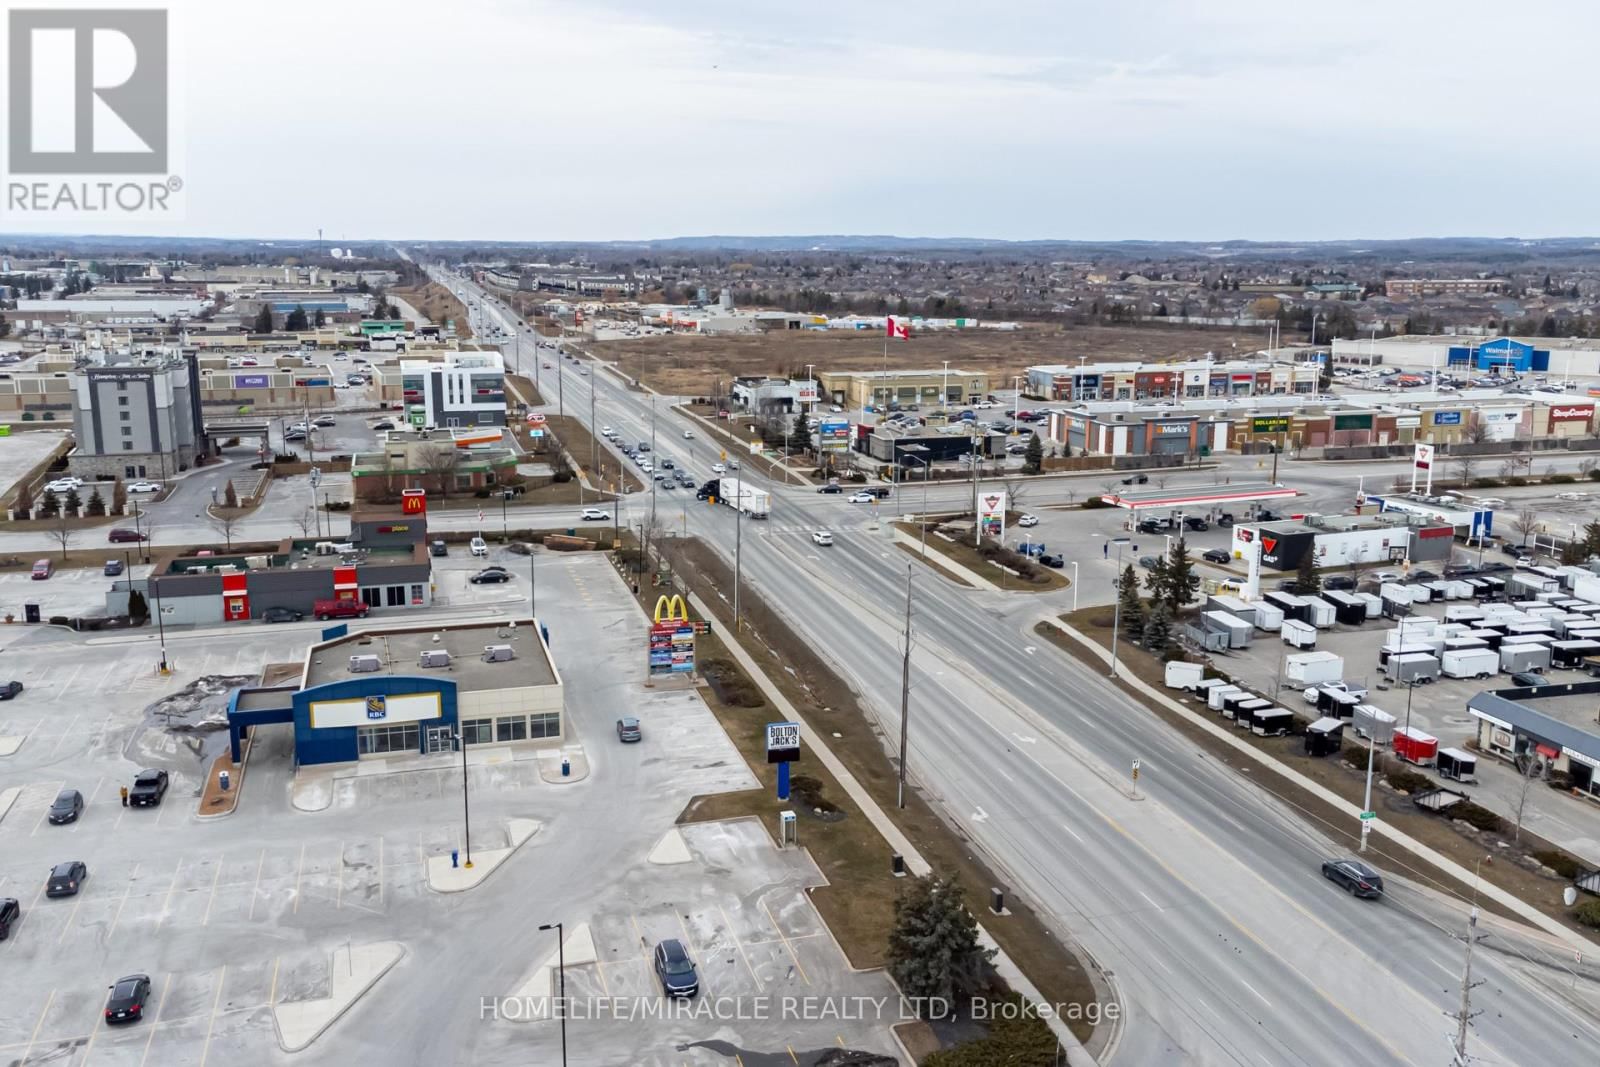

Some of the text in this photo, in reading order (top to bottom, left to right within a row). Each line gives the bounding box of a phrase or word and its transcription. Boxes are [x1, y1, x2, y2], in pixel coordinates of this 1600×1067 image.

[1485, 347, 1513, 355] Walmat
[1162, 425, 1188, 433] Mark's
[770, 726, 798, 737] BOLTON
[770, 736, 797, 746] JACK'S
